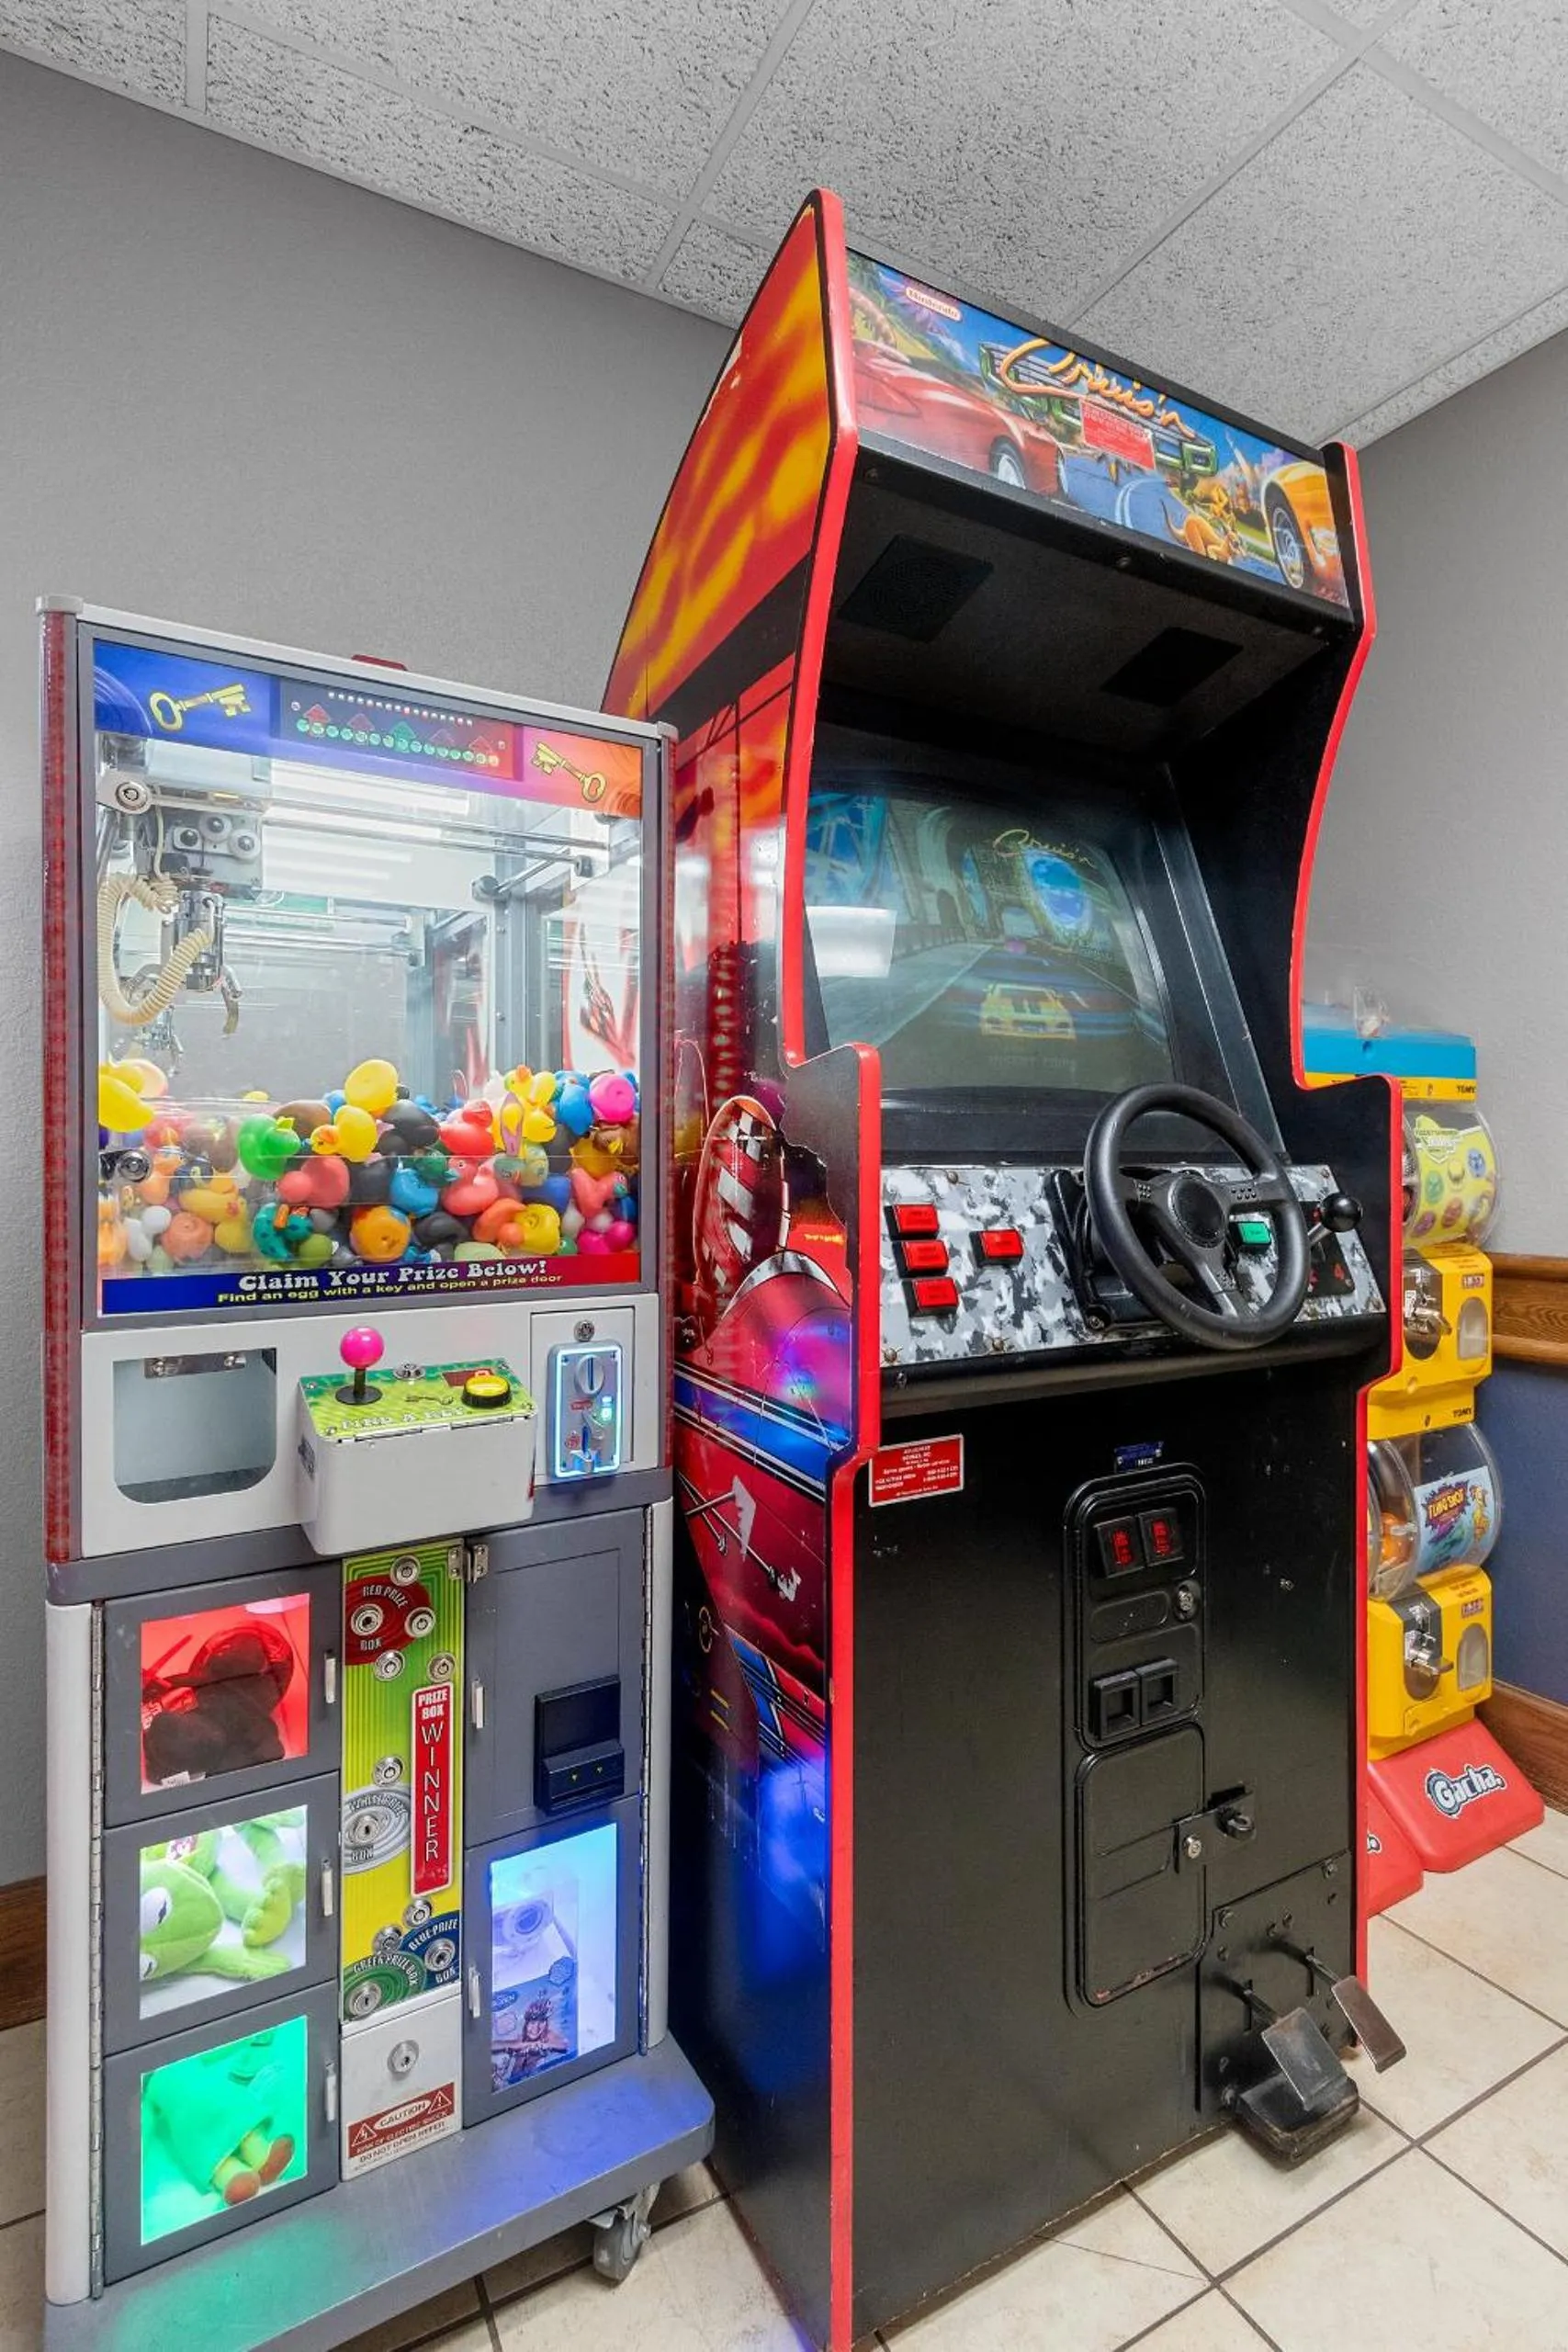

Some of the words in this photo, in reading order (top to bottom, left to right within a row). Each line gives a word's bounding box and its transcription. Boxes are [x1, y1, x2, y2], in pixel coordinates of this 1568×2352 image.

[238, 1274, 319, 1291] Claim
[328, 1271, 390, 1286] Your
[398, 1266, 459, 1282] Prize
[467, 1261, 547, 1277] Below!
[218, 1292, 257, 1303] Find
[262, 1292, 283, 1301] an
[288, 1290, 320, 1299] egg
[323, 1287, 357, 1296] with
[376, 1284, 402, 1294] key
[408, 1282, 435, 1291] and
[439, 1280, 476, 1290] open
[493, 1276, 526, 1285] prize
[531, 1274, 562, 1283] door
[362, 1585, 382, 1597] RED
[418, 1689, 448, 1706] PRIZE
[421, 1704, 445, 1720] BOX
[421, 1721, 444, 1862] WINNER
[432, 1918, 458, 1936] PRIZE
[380, 2101, 426, 2127] CAUTION
